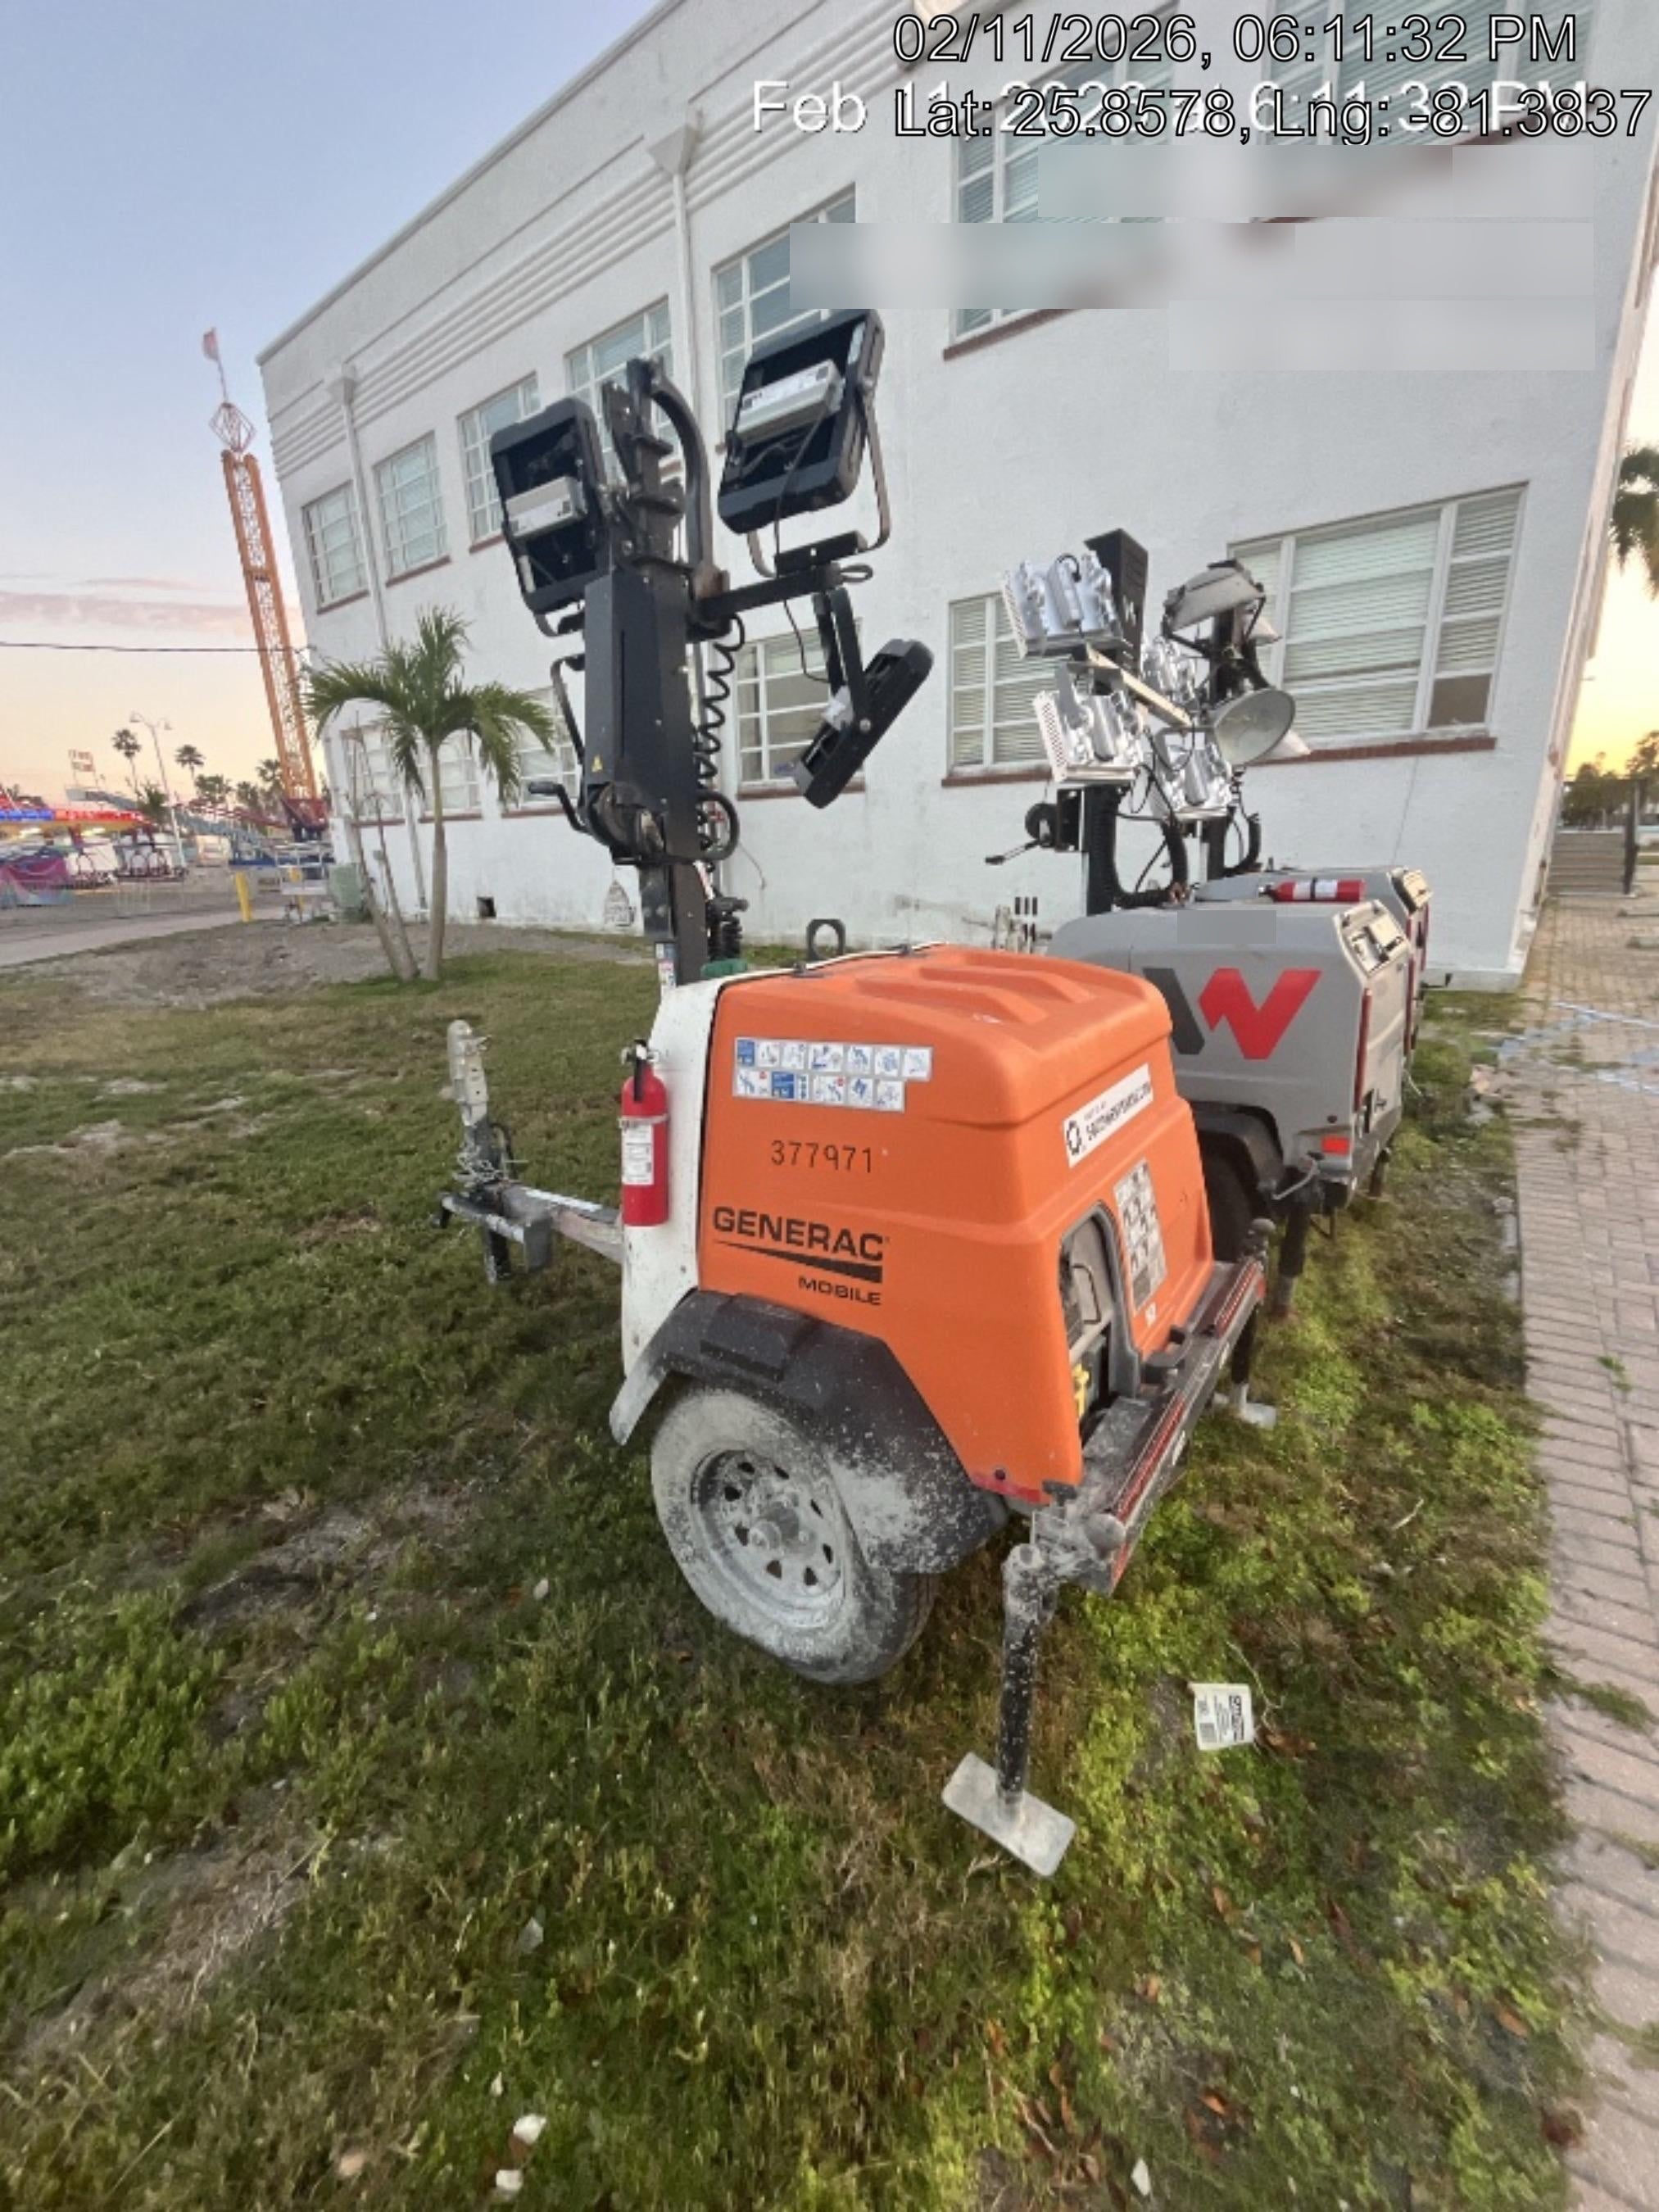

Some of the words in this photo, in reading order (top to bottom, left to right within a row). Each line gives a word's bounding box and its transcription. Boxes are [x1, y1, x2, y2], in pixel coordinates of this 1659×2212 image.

[770, 1140, 872, 1173] 377971
[713, 1206, 883, 1262] GENERAC
[798, 1276, 882, 1306] MOBILE
